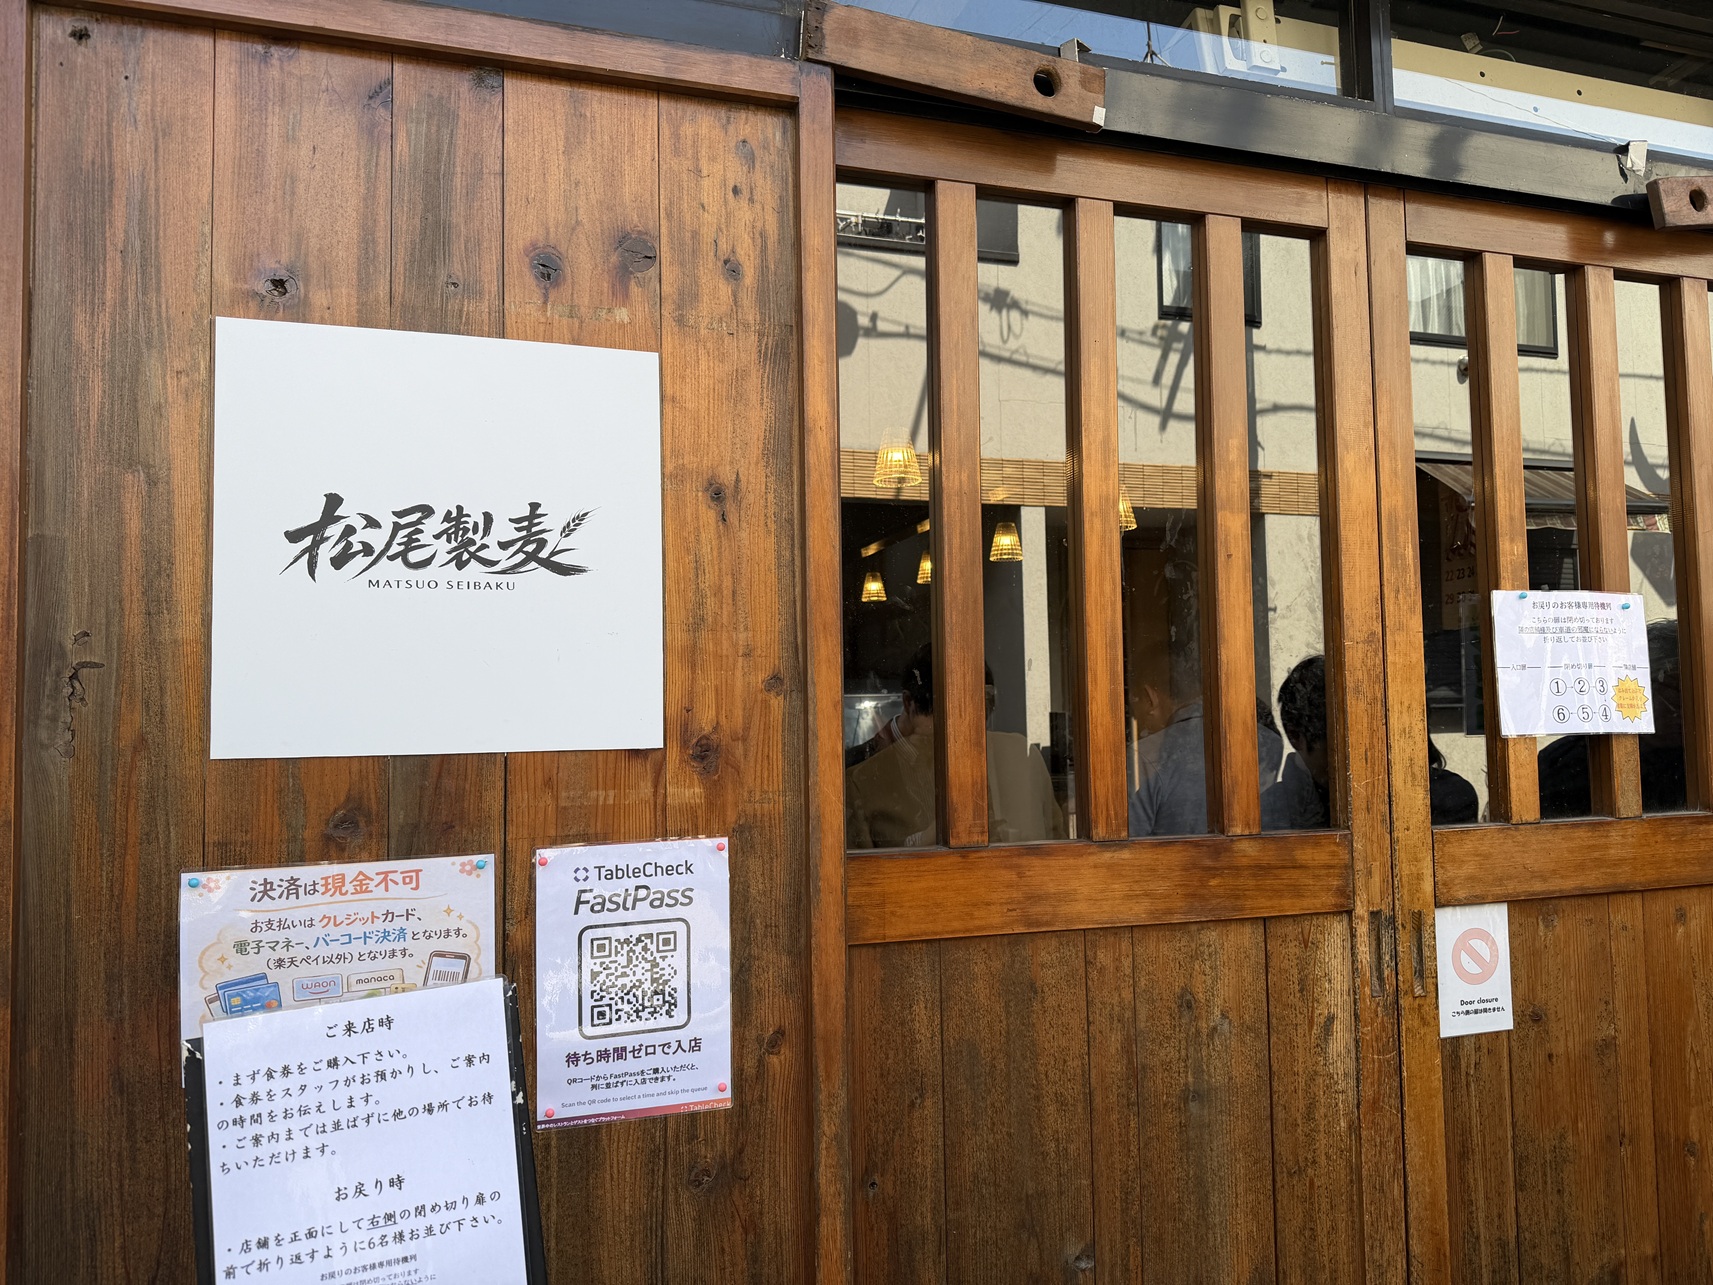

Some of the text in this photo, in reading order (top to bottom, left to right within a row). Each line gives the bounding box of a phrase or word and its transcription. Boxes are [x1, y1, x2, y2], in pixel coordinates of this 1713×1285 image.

[279, 492, 597, 583] 松尾製麦
[368, 579, 516, 591] MATSUO SEIBAKU
[249, 868, 423, 902] 決済は現金不可
[594, 860, 694, 882] TableCheck
[573, 884, 695, 916] FastPass
[355, 974, 395, 985] manaca
[1477, 997, 1499, 1005] closure
[325, 1014, 395, 1039] ご来店時
[565, 1037, 702, 1068] 待ち時間ゼロで入店
[590, 1075, 676, 1092] 列に並ばずに入店できます。
[217, 1092, 380, 1131] の時間をお伝えします。
[561, 1101, 576, 1109] Scan
[588, 1098, 597, 1106] QR
[667, 1089, 680, 1097] skip
[219, 1143, 338, 1176] ちいただけます。
[335, 1173, 406, 1202] お戻り時
[222, 1214, 503, 1280] 前で折り返すように6名様お並び下さい。
[320, 1253, 418, 1282] お戻りのお客様専用待機列
